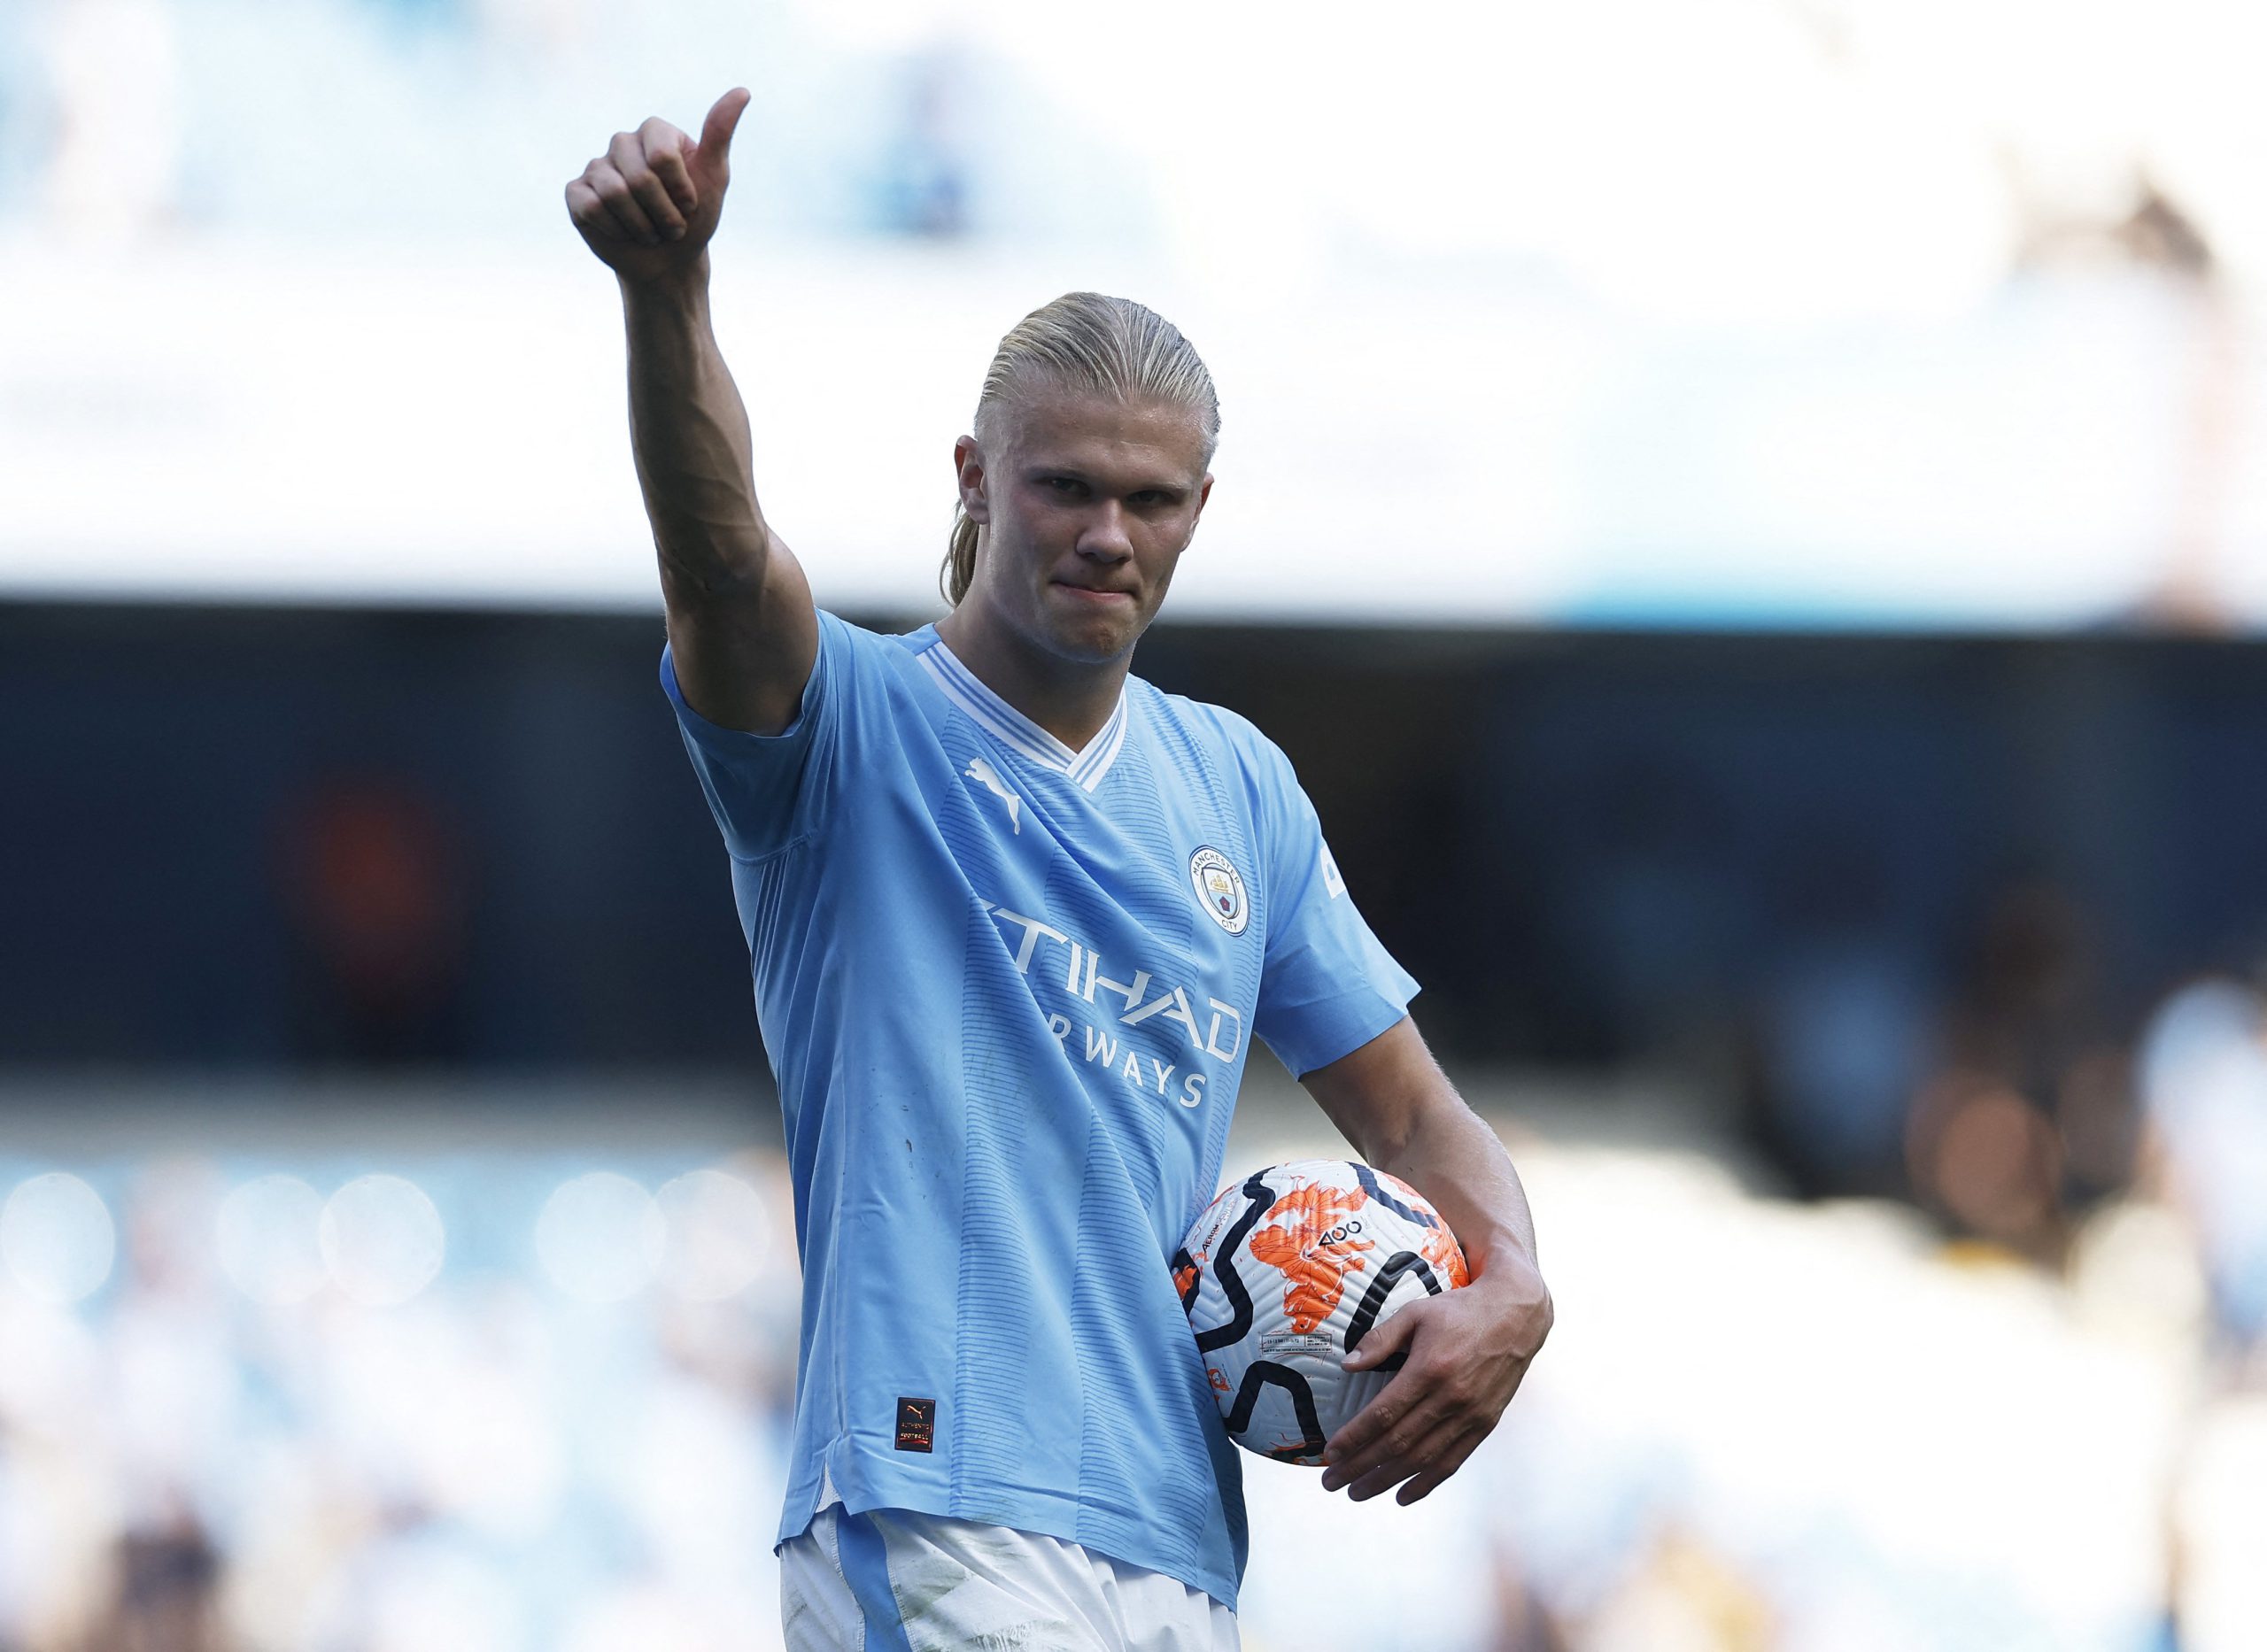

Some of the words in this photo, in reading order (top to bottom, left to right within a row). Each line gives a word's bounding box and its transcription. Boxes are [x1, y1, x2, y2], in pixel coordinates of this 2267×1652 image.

[1192, 852, 1240, 884] MANCHESTER
[1221, 919, 1238, 930] CITY
[977, 897, 1242, 1064] TIHAD
[1047, 1012, 1207, 1108] RWAYS
